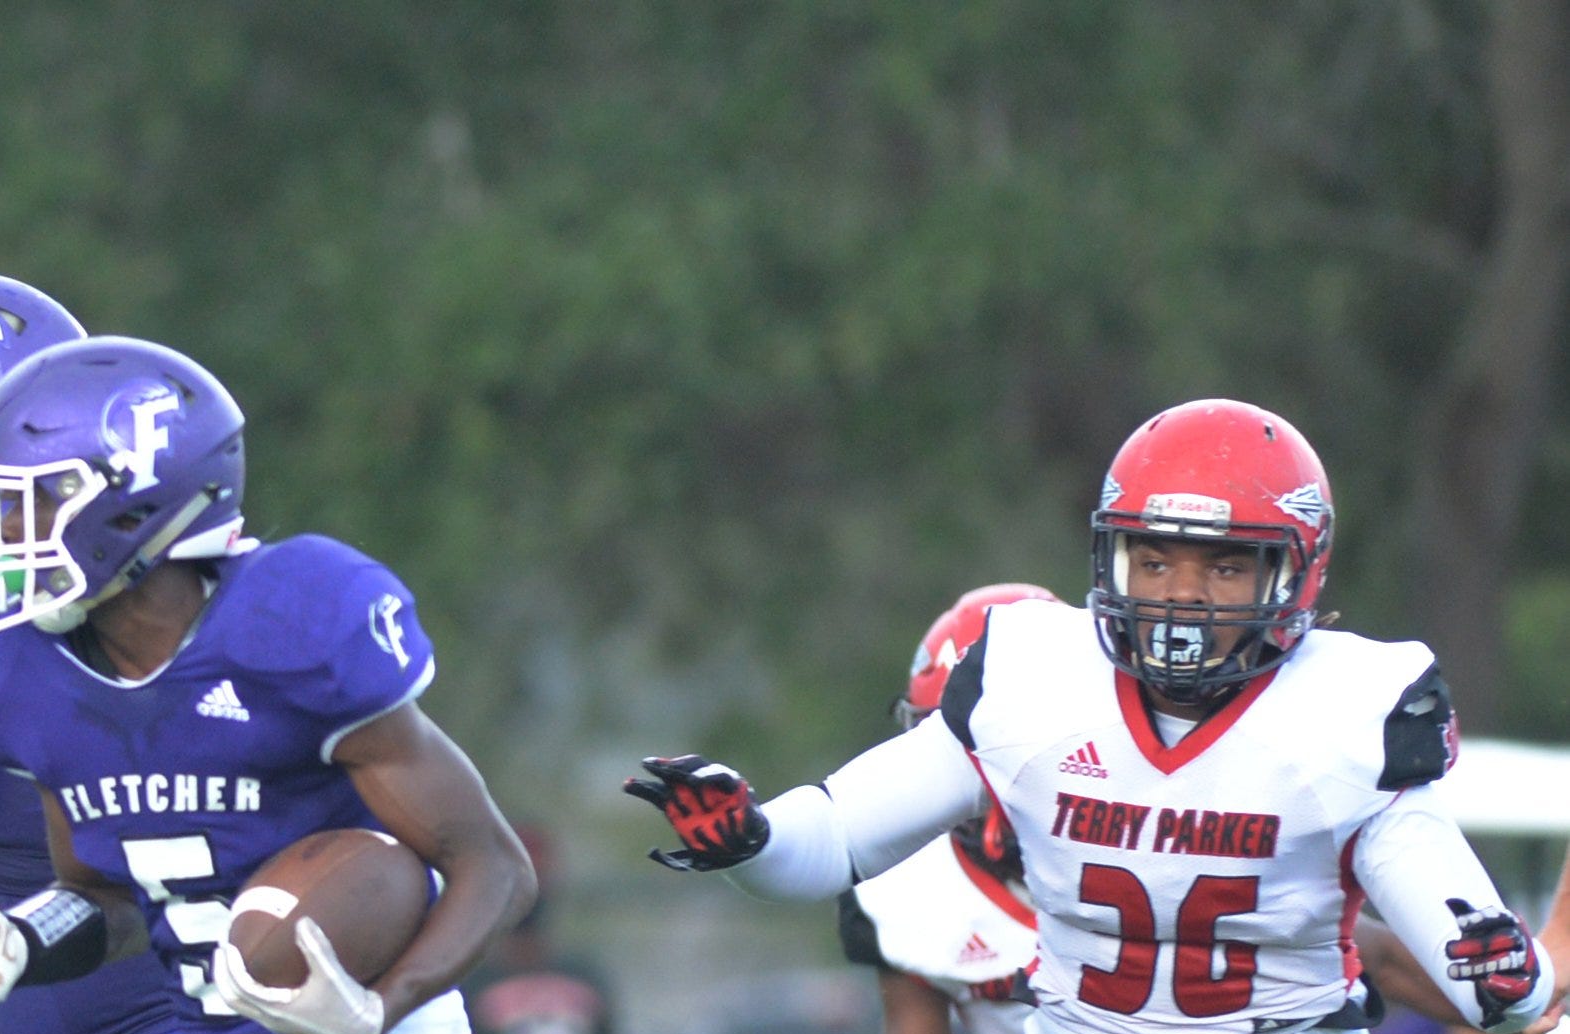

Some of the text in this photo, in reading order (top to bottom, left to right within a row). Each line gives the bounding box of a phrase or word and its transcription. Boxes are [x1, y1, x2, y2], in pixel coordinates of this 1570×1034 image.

[127, 390, 180, 495] F
[380, 597, 411, 668] F
[60, 774, 262, 823] FLETCHER
[1057, 761, 1109, 779] adidas
[1051, 791, 1281, 859] TERRY PARKER
